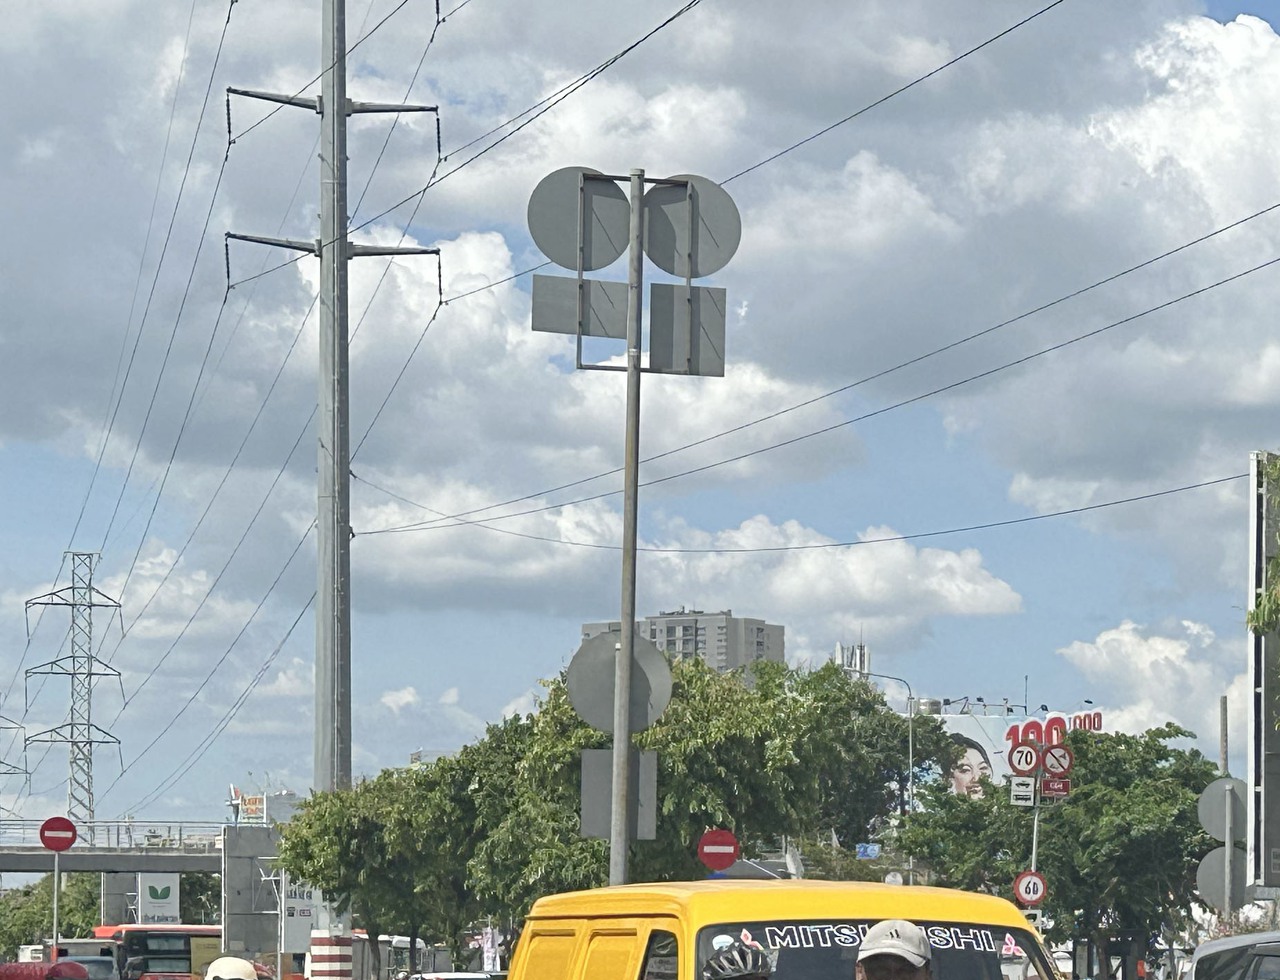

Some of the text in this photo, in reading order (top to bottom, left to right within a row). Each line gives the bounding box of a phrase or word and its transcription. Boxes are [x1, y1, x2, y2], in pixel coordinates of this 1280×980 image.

[1016, 750, 1034, 766] 70
[1025, 880, 1039, 895] 60
[765, 924, 997, 952] MITSSHI
